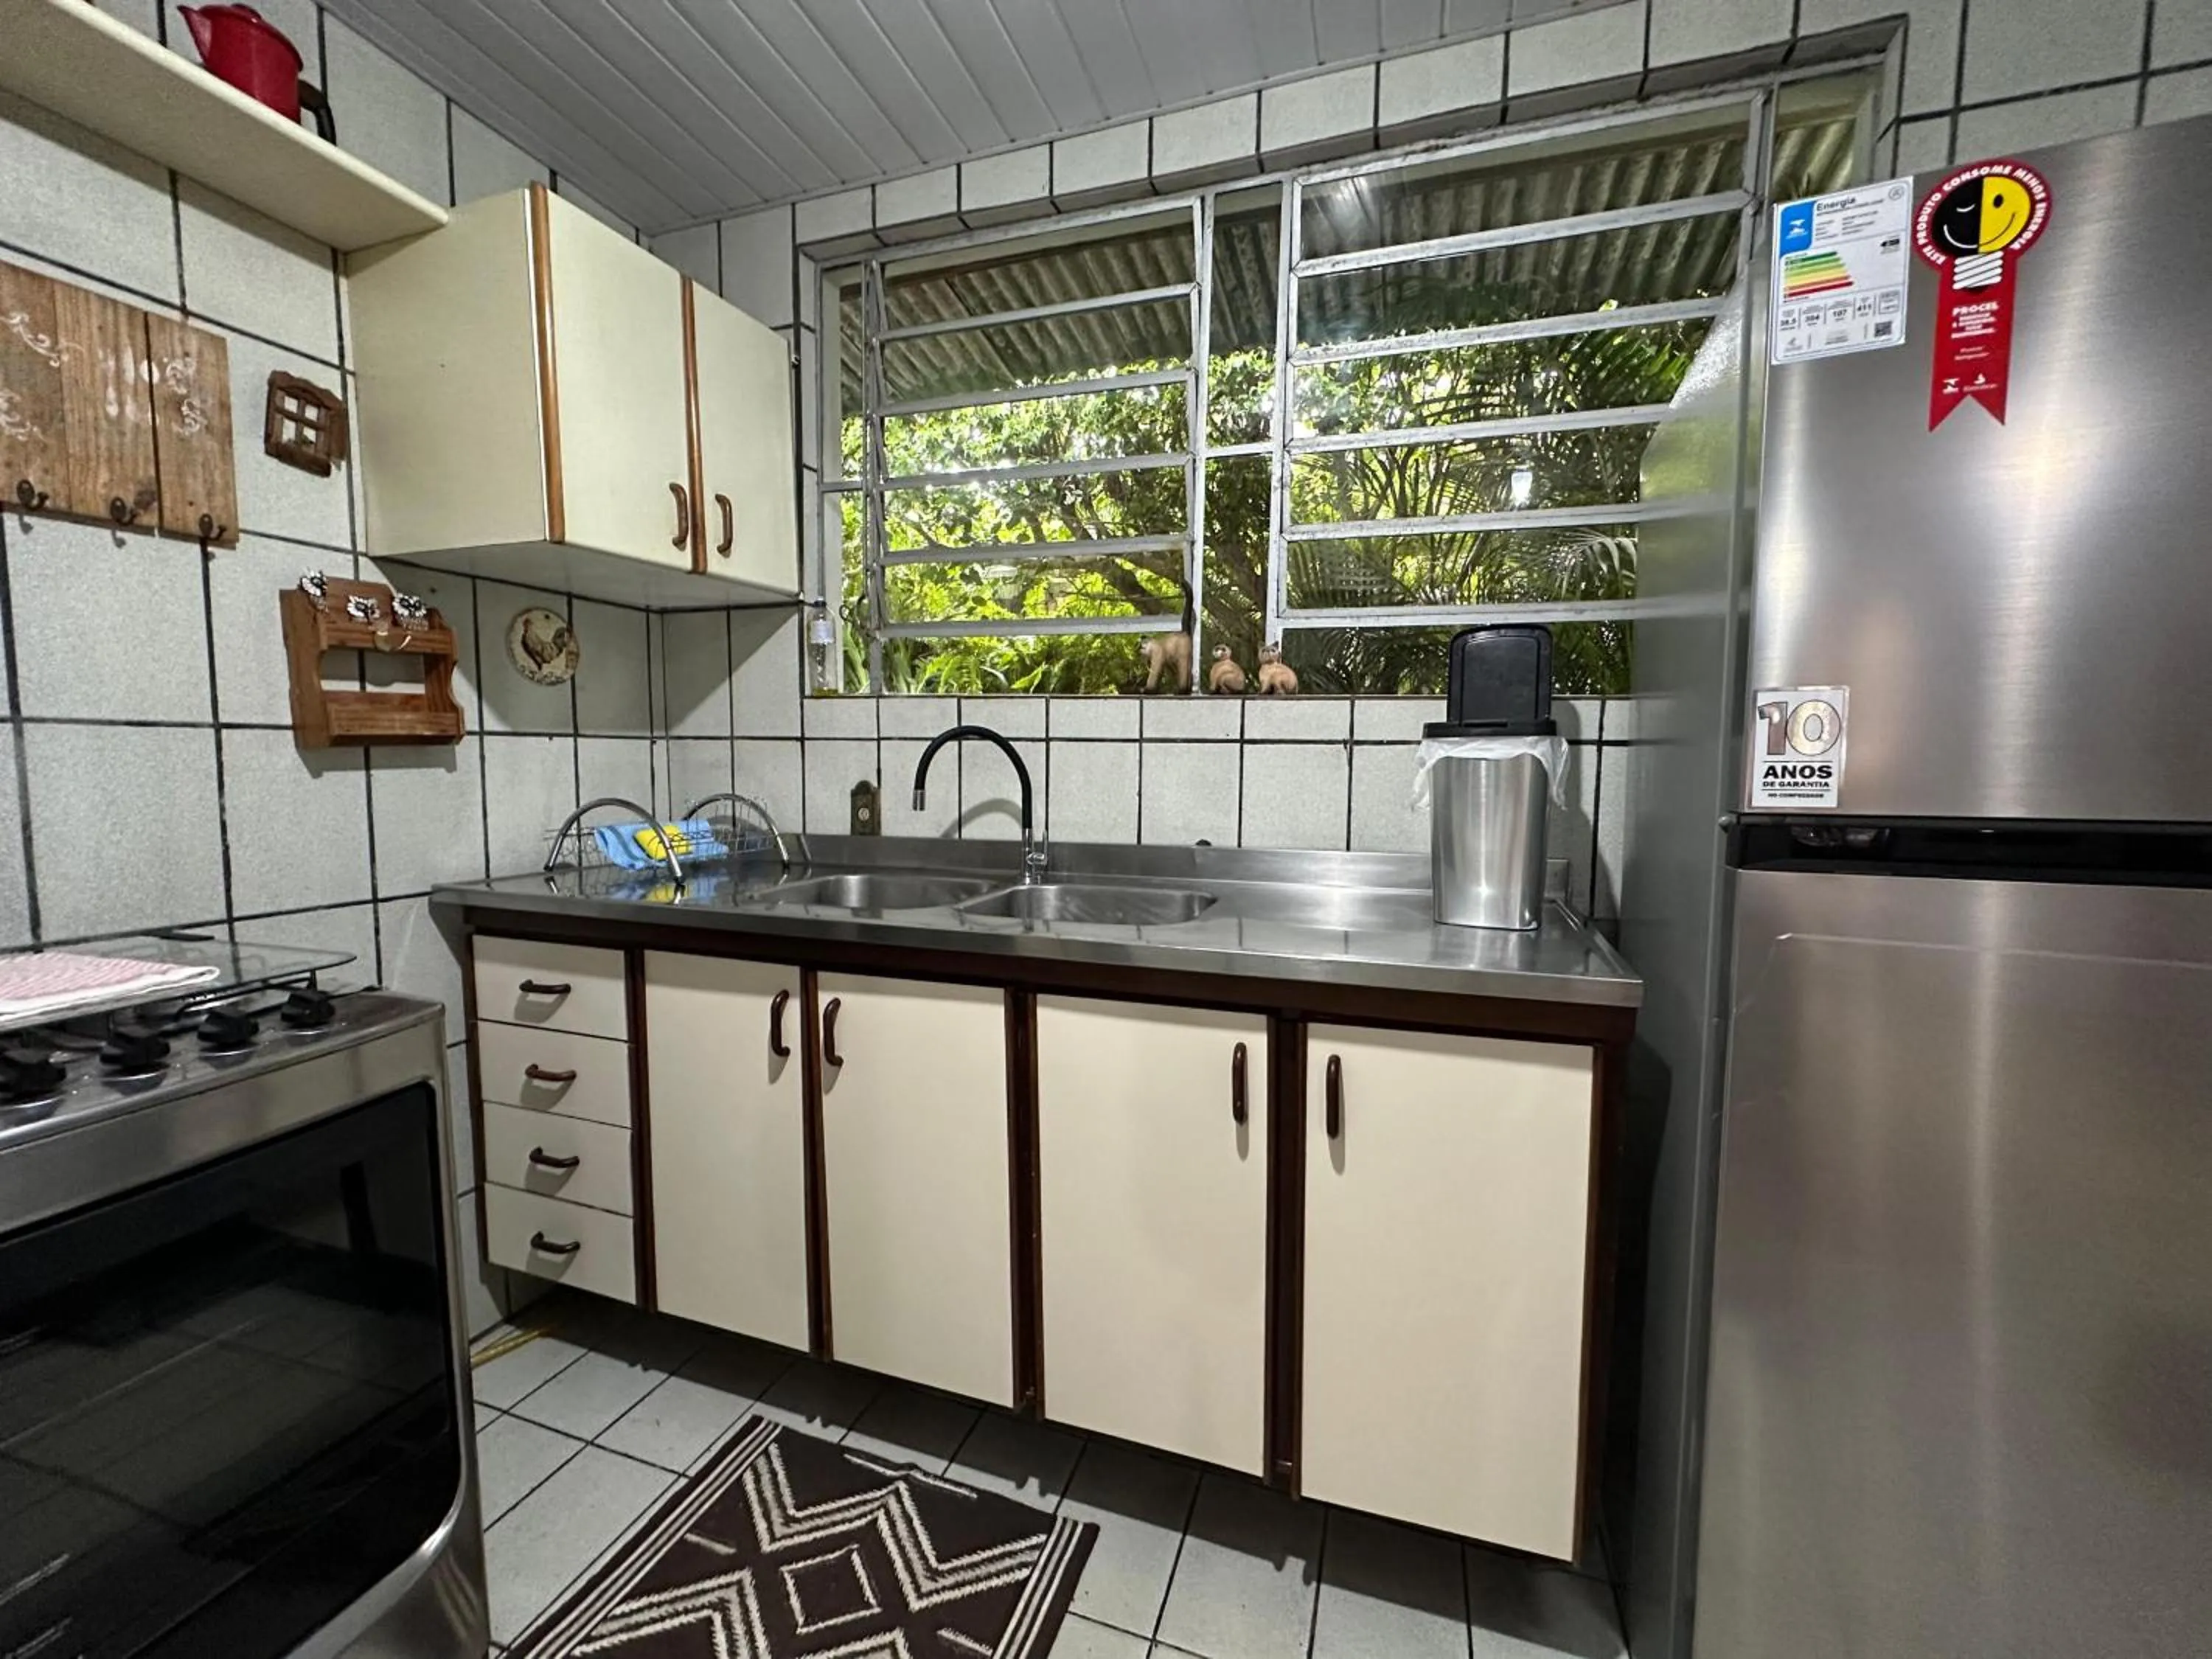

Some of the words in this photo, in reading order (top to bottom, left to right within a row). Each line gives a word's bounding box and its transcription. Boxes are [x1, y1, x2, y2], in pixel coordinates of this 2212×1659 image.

[1943, 165, 2013, 191] CONSOME
[2012, 168, 2046, 200] MENOS
[1816, 196, 1856, 212] Energia
[1916, 192, 1941, 245] PRODUTO
[2009, 202, 2047, 250] ENERGIA
[1922, 245, 1947, 265] ESTE
[1758, 699, 1841, 757] 10
[1762, 765, 1832, 779] ANOS
